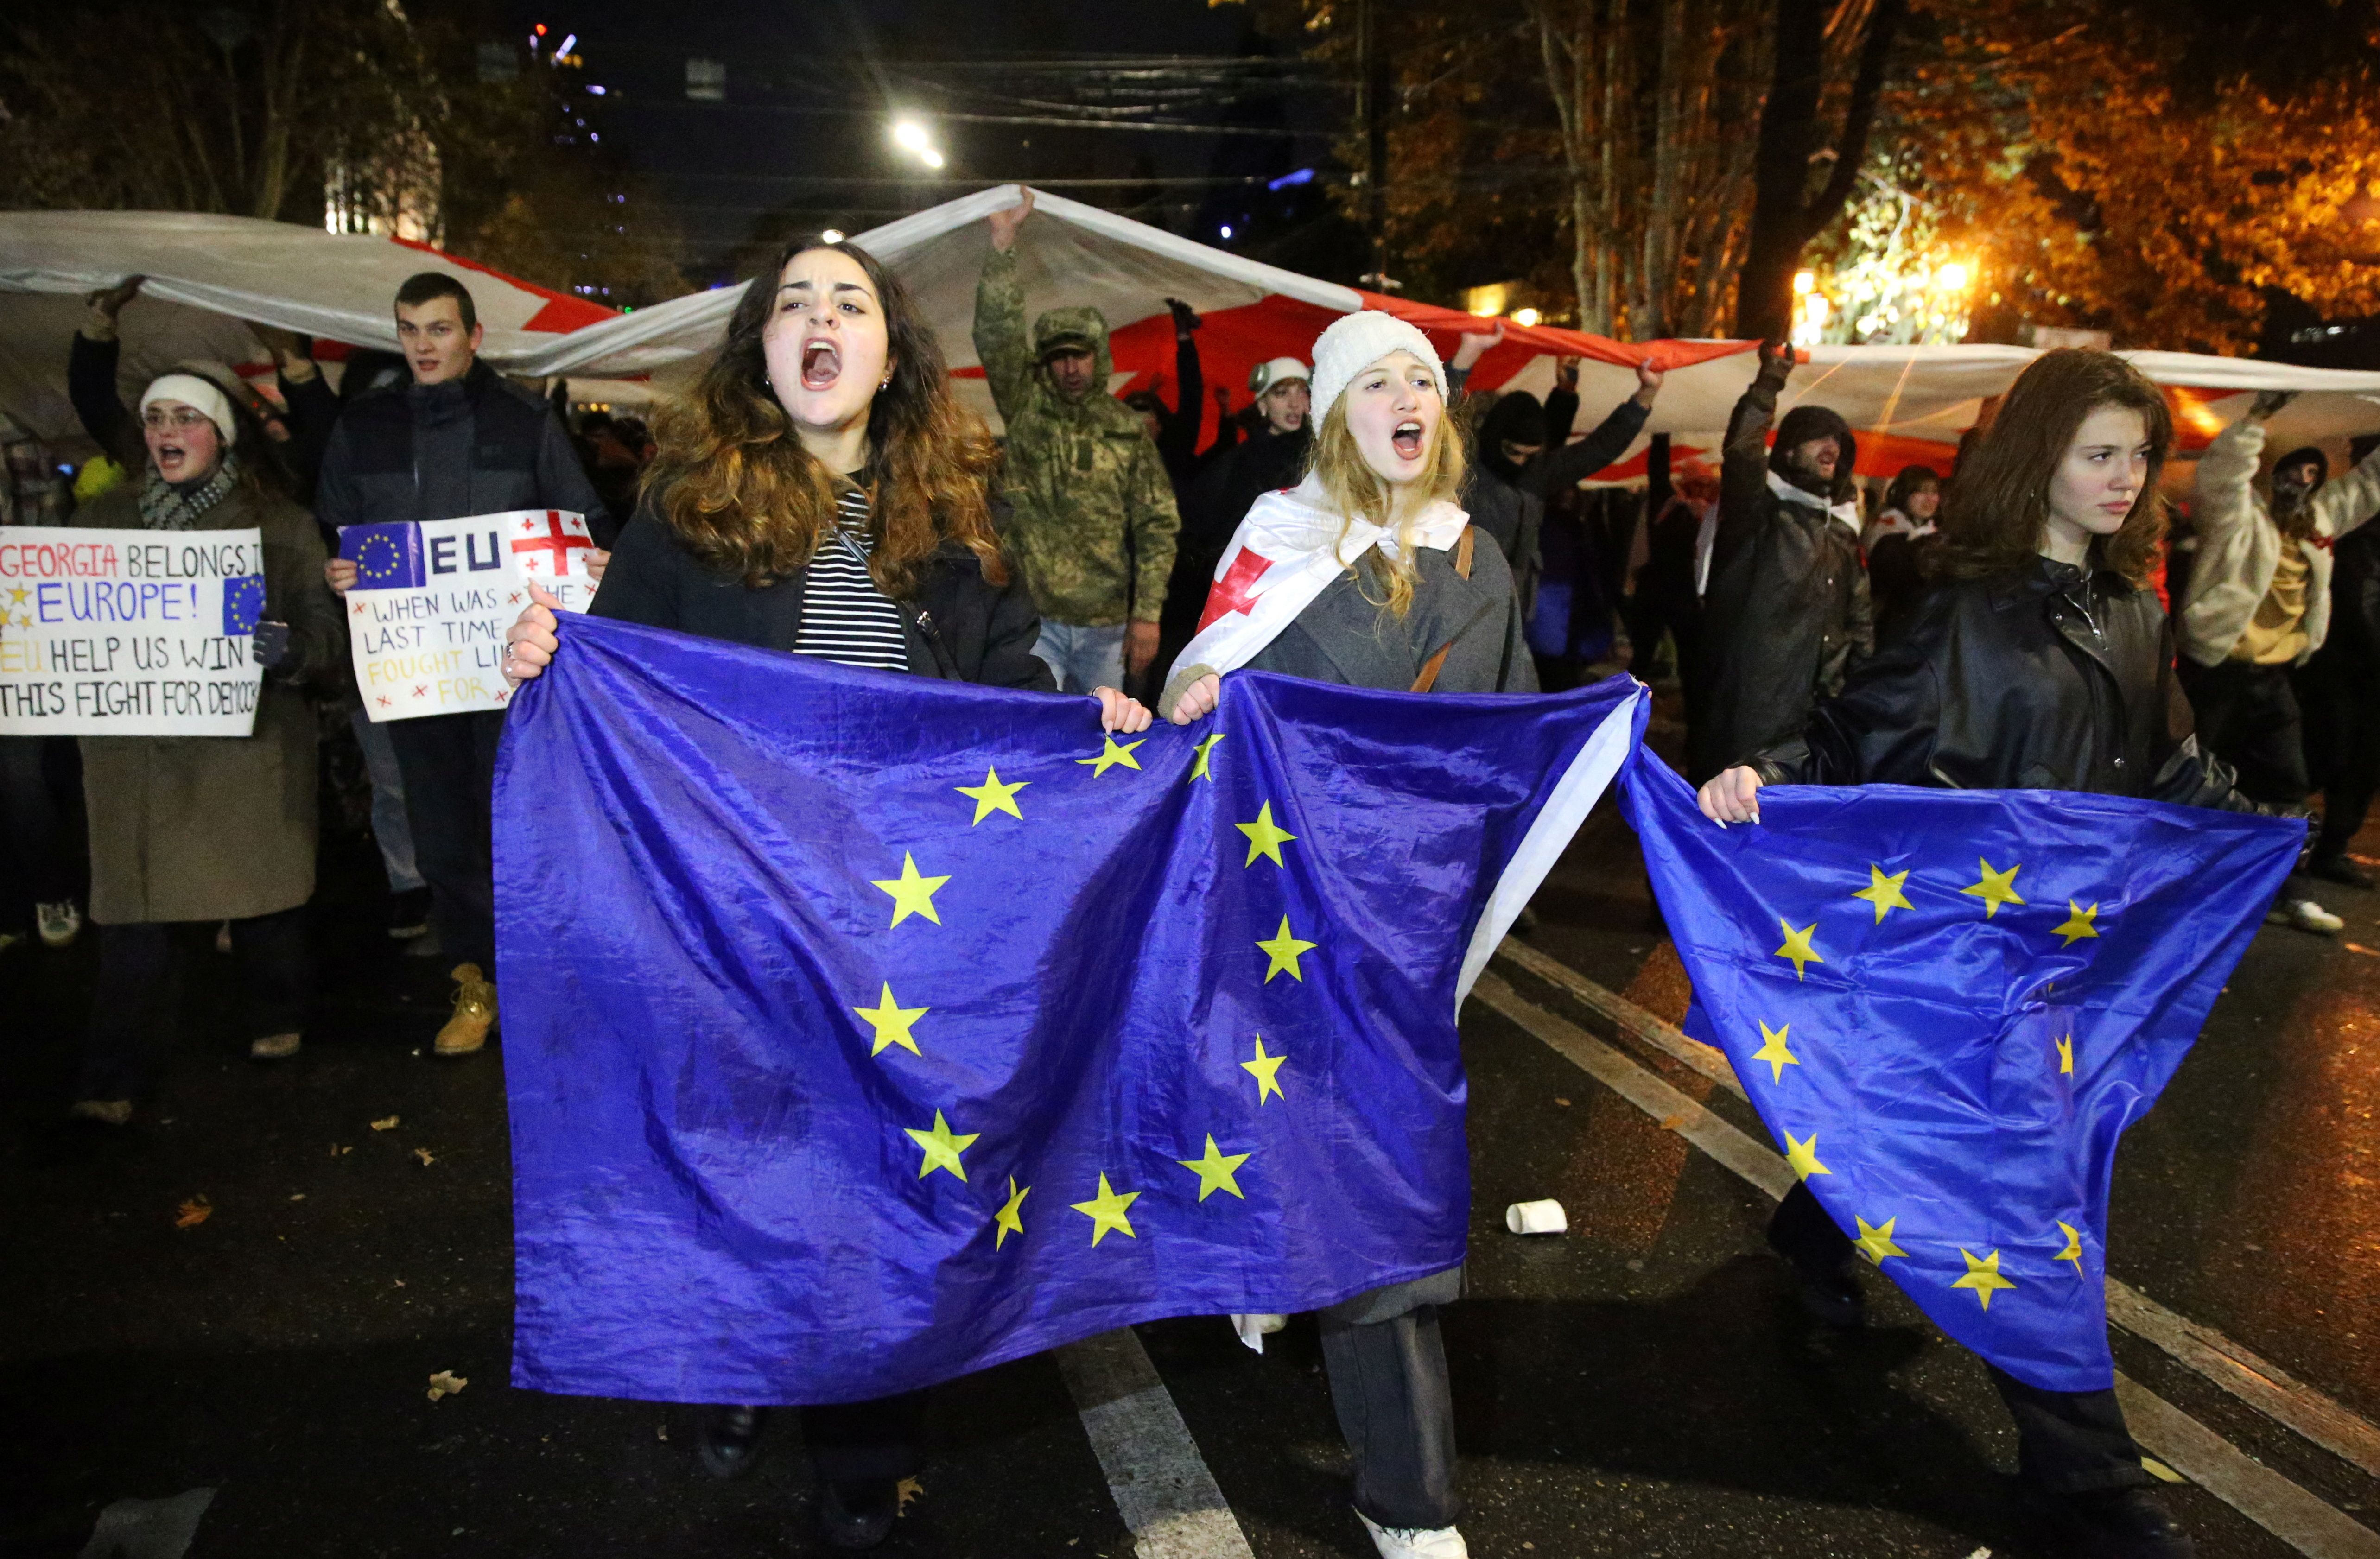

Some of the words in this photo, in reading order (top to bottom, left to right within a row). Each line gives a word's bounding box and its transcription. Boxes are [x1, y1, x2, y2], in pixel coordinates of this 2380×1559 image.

[0, 543, 118, 577] GEORGIA
[127, 544, 246, 578] BELONGS
[429, 531, 501, 575] EU
[37, 581, 197, 623] EUROPE!
[372, 594, 440, 623] WHEN
[451, 589, 497, 613] WAS
[524, 584, 575, 604] HE
[0, 640, 45, 673] EU
[50, 636, 120, 672] HELP
[133, 637, 170, 670] US
[179, 637, 243, 671] WIN
[364, 626, 425, 654] LAST
[441, 618, 502, 644] TIME
[368, 650, 463, 685] FOUGHT
[475, 643, 505, 668] LI
[0, 681, 65, 717] THIS
[75, 681, 157, 717] FIGHT
[162, 680, 202, 716] FOR
[437, 677, 490, 704] FOR
